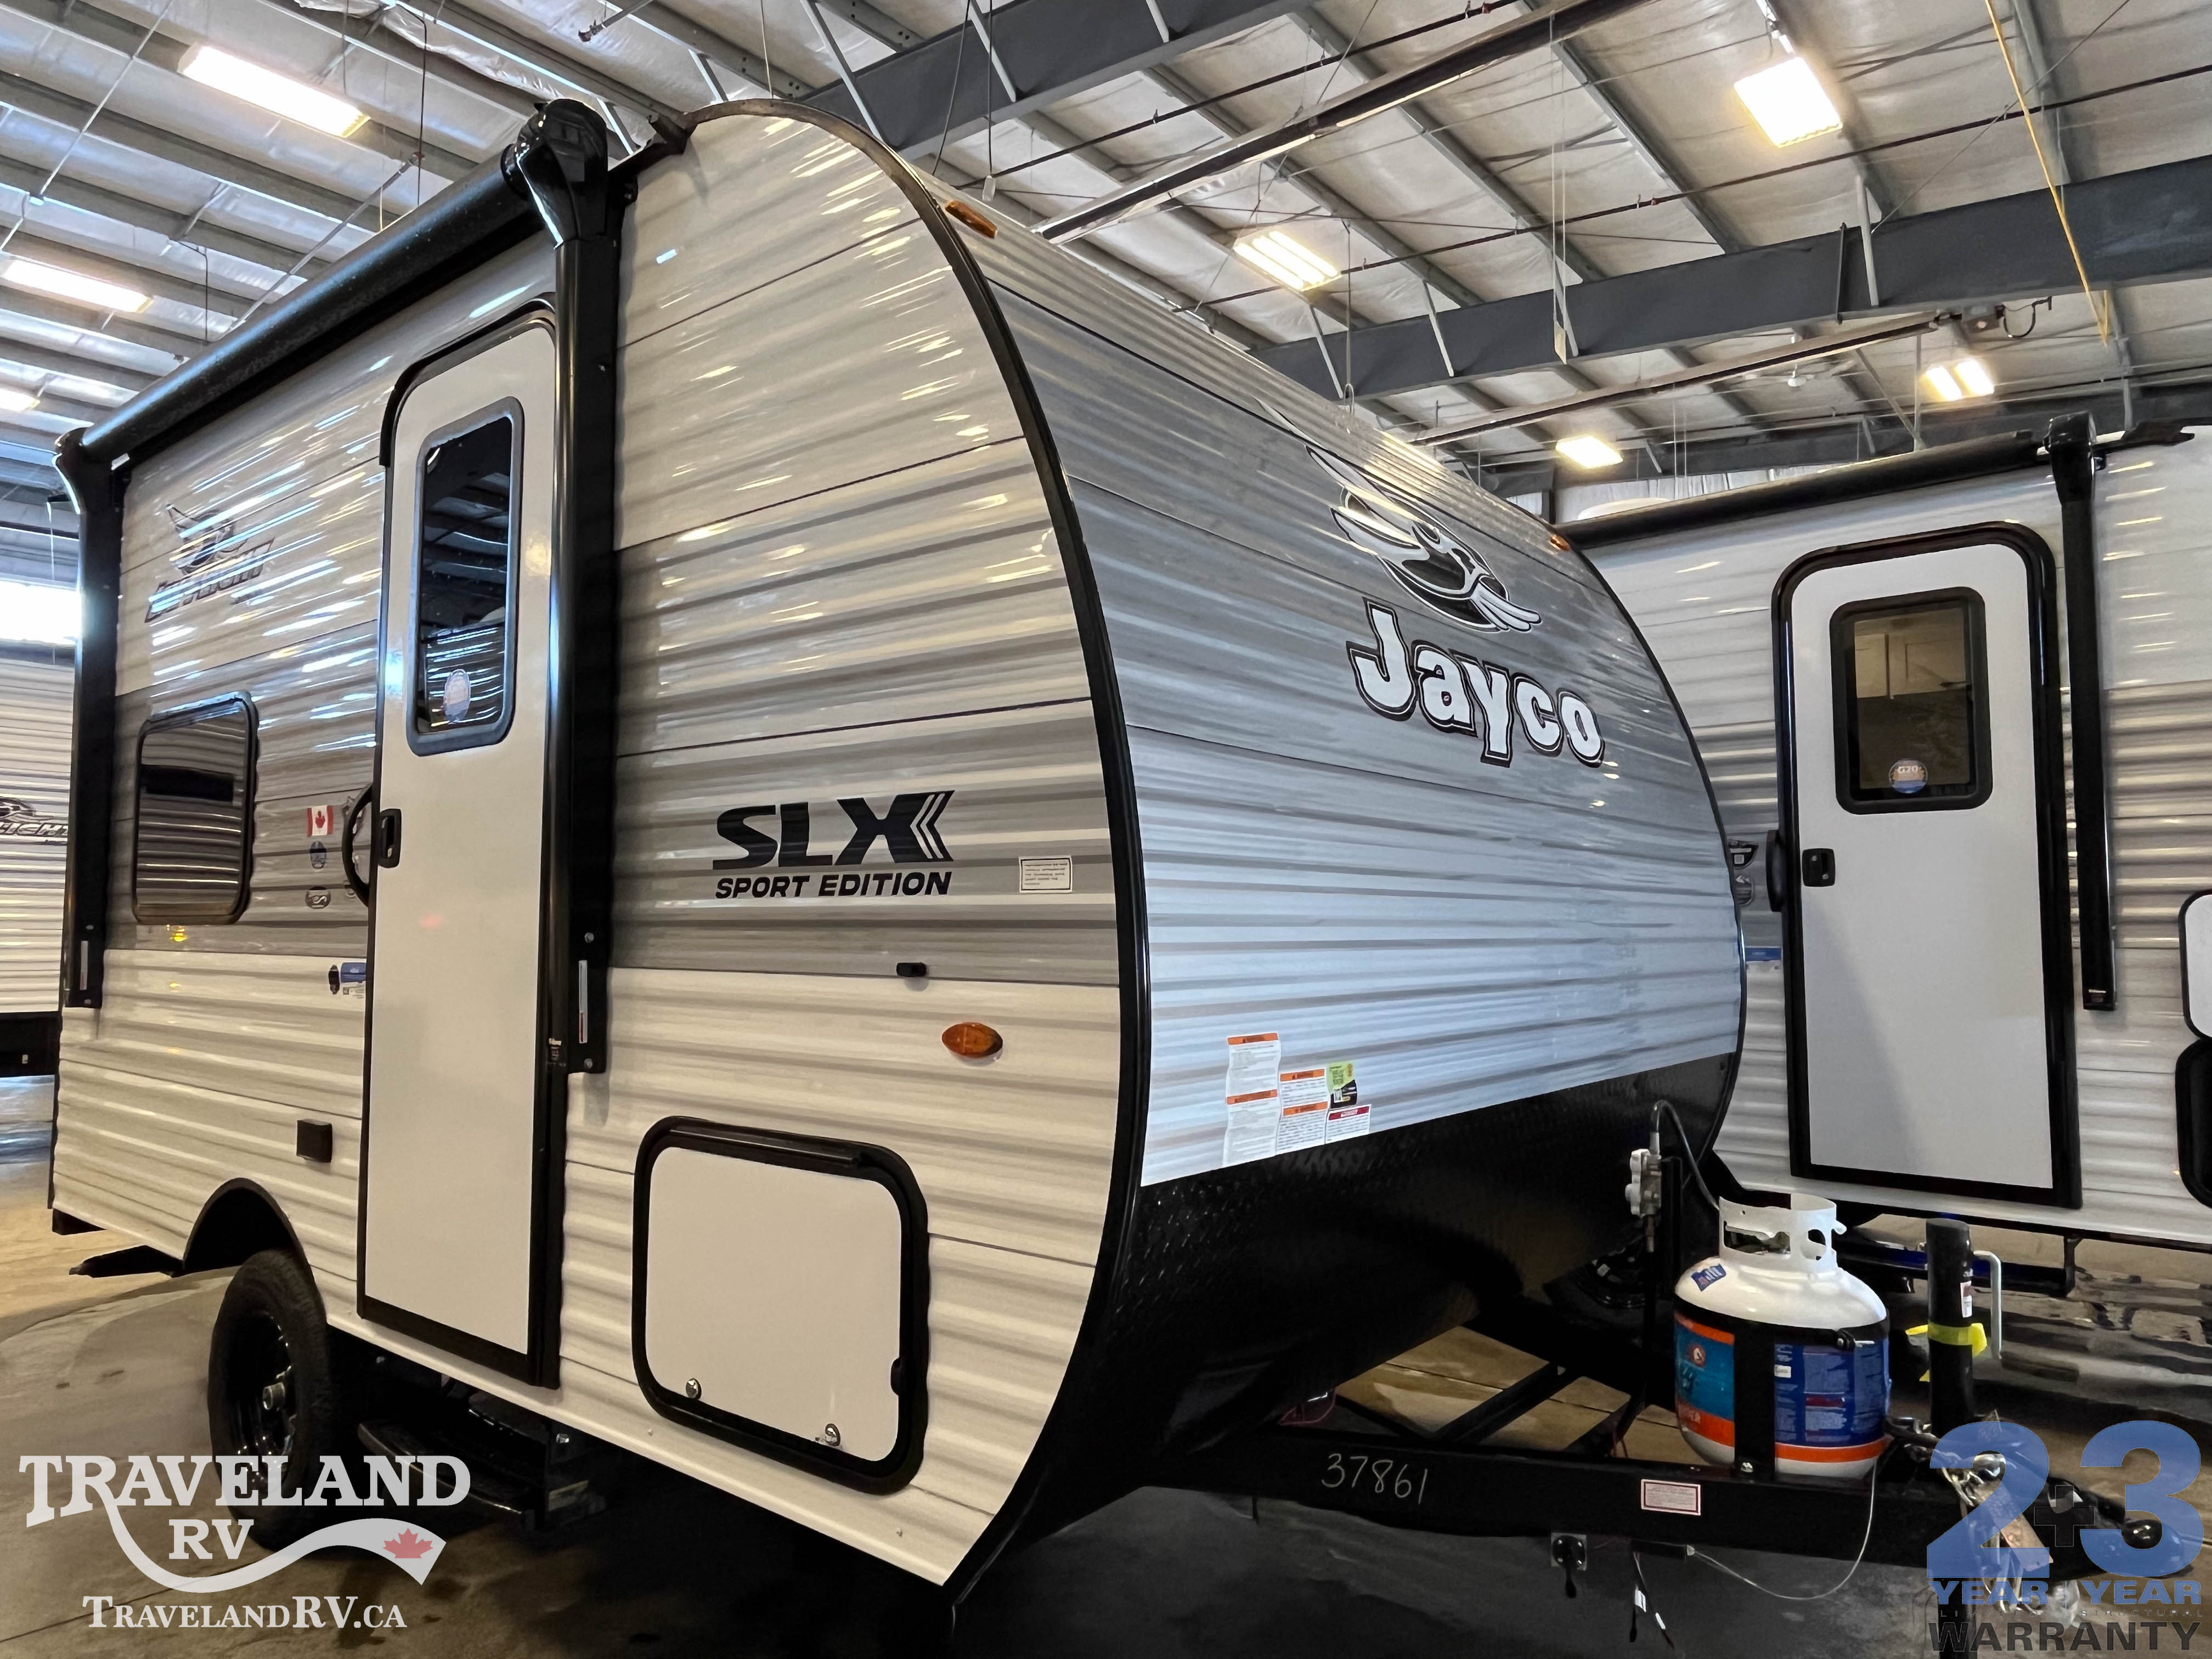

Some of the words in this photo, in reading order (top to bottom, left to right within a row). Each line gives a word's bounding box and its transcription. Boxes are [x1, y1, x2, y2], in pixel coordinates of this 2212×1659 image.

[1346, 597, 1605, 768] Jayco
[713, 790, 955, 870] SLX
[715, 875, 810, 899] SPORT
[819, 871, 952, 897] EDITION
[1321, 1453, 1428, 1505] 37861
